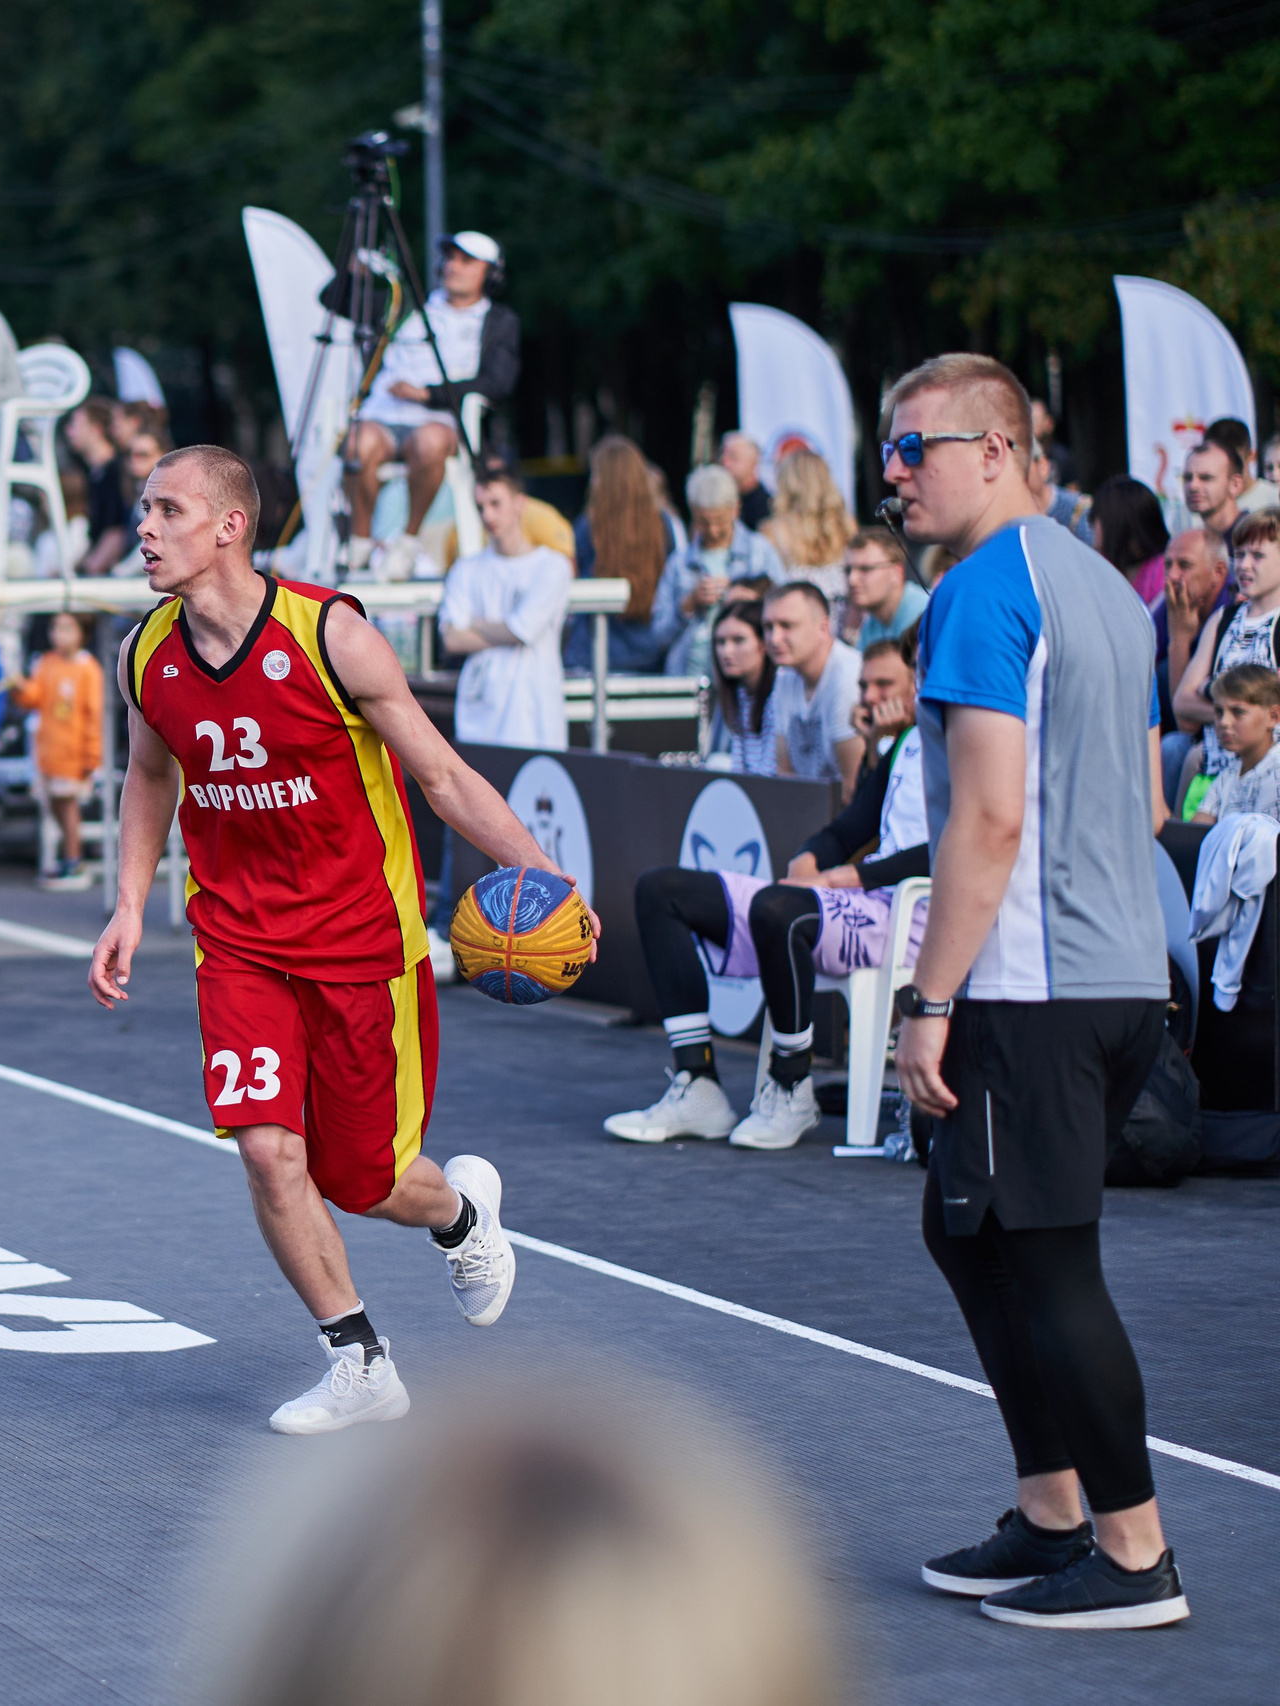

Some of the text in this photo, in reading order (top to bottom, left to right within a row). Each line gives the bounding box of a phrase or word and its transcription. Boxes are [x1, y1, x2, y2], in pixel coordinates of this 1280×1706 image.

[195, 716, 268, 771] 23
[188, 776, 318, 811] ВОРОНЕЖ
[210, 1046, 281, 1106] 23
